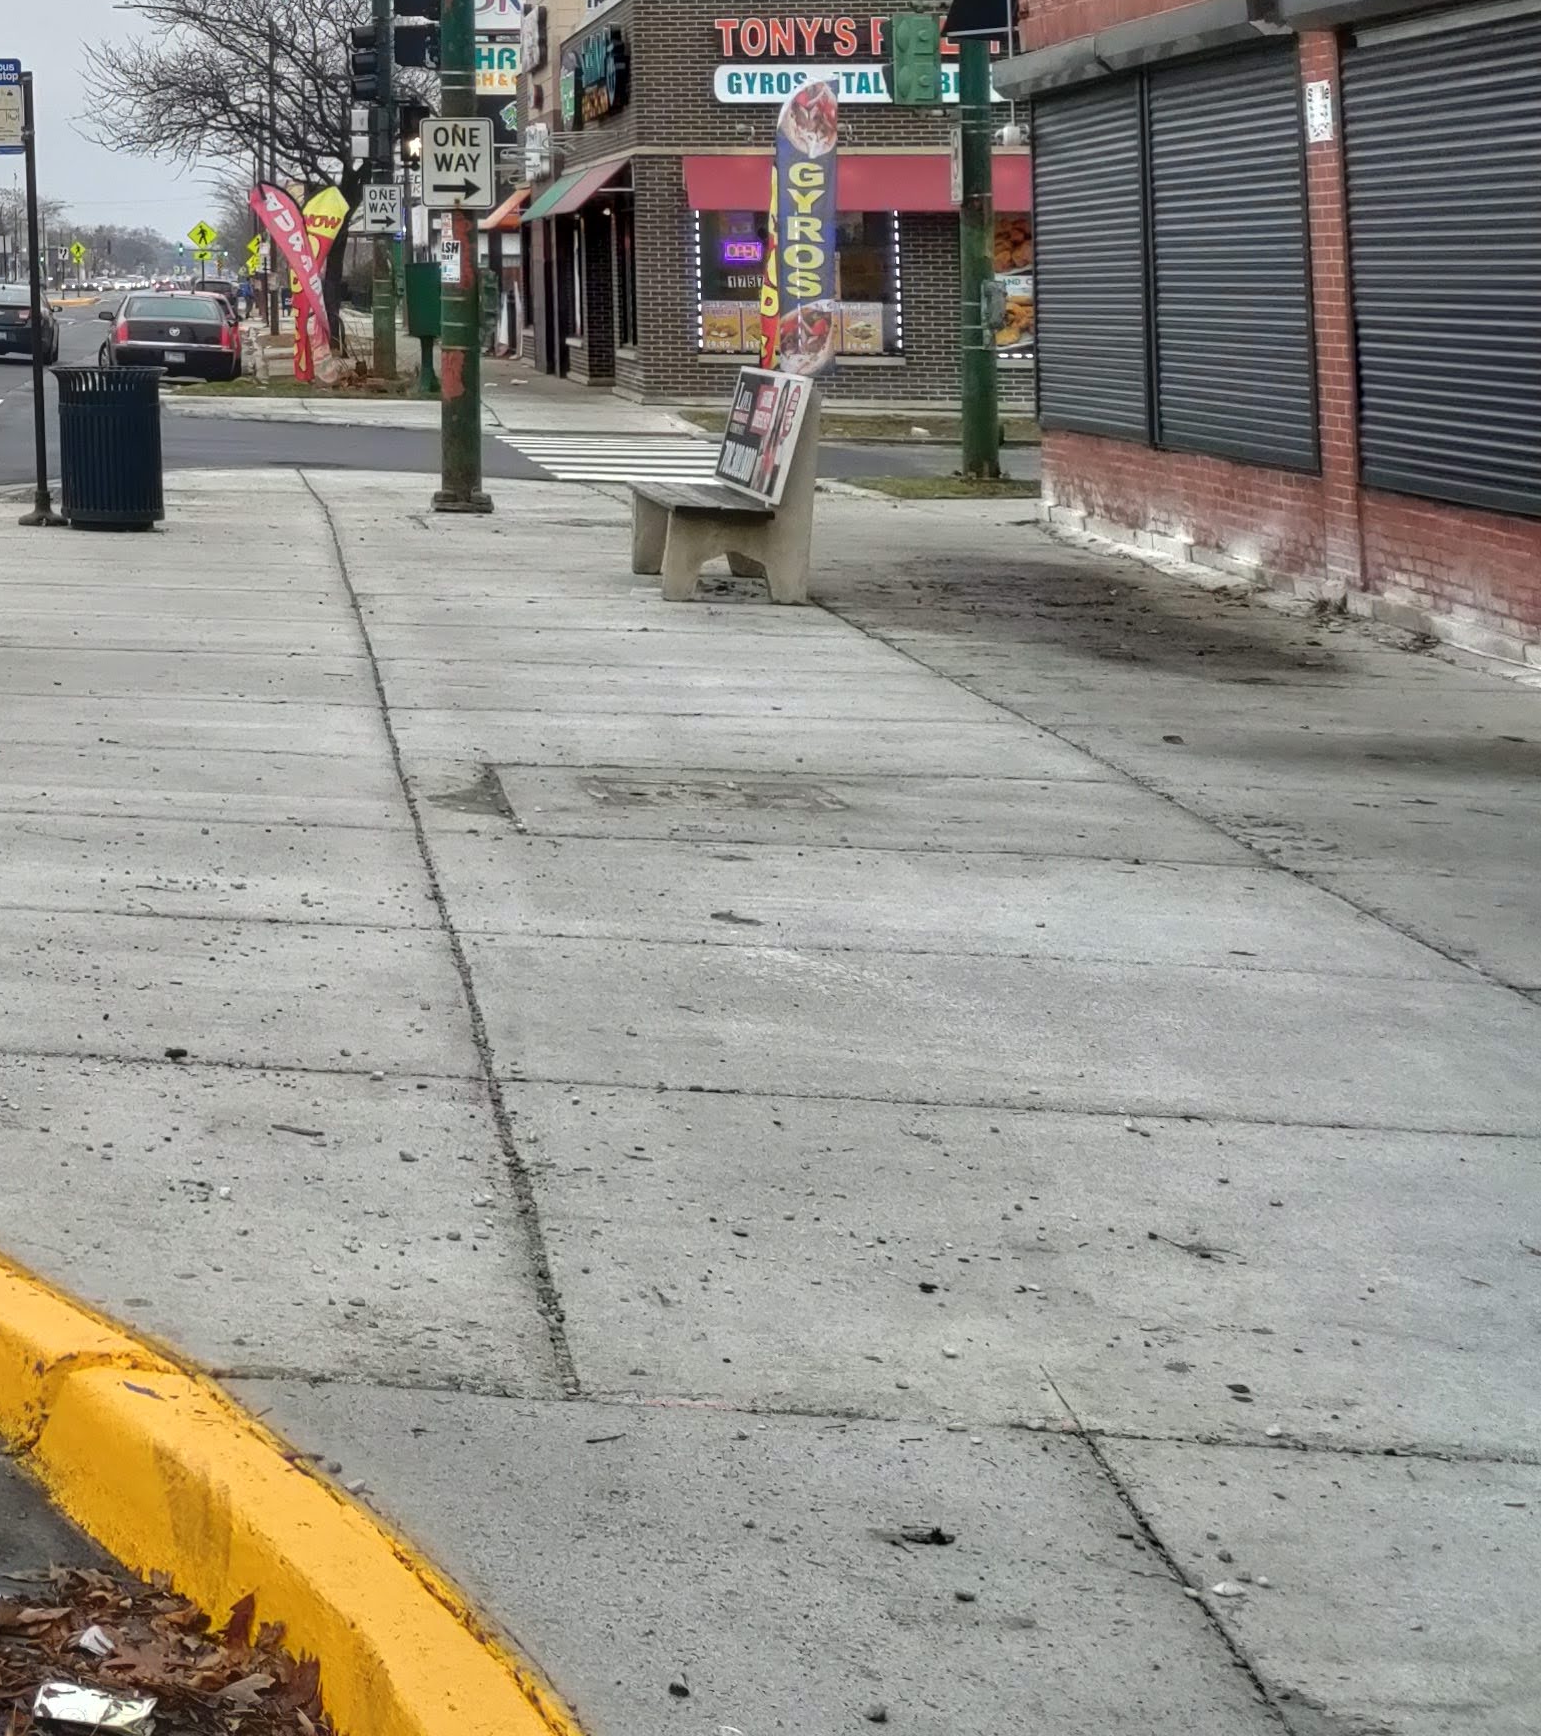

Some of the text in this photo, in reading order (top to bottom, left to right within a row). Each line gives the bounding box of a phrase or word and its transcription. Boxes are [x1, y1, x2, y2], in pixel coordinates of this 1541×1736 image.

[714, 17, 857, 57] TONY'S
[433, 127, 480, 147] ONE
[434, 153, 481, 172] WAY
[369, 189, 396, 200] ONE
[369, 202, 397, 213] WAY
[305, 214, 341, 229] NOW
[784, 162, 825, 297] GYROS
[727, 244, 759, 258] OPEN
[728, 275, 764, 288] 1757
